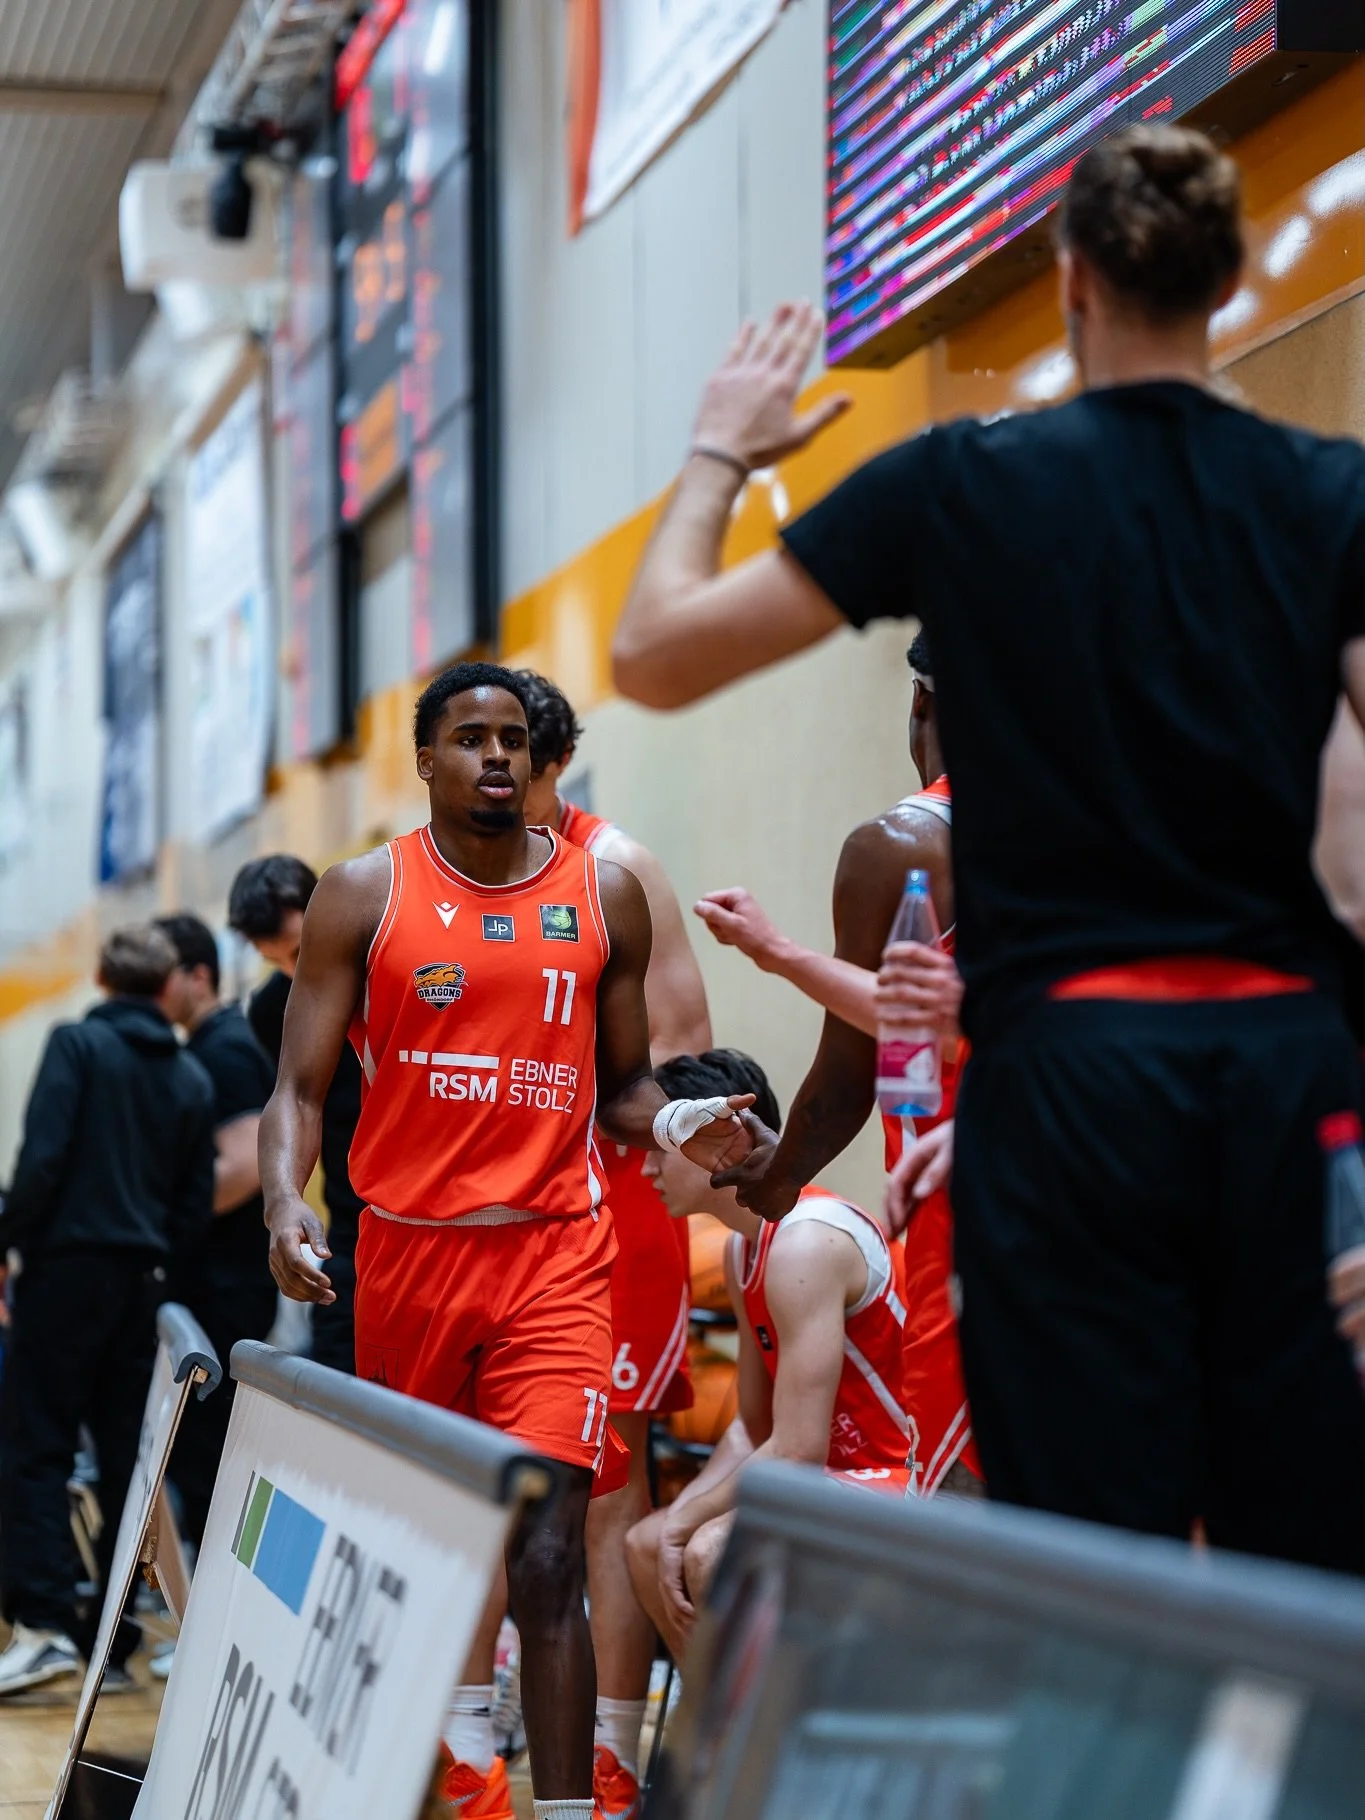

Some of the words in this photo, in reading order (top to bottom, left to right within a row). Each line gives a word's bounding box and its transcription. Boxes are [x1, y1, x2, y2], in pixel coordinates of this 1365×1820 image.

[545, 930, 577, 940] BARMER
[418, 987, 462, 998] DRAGONS
[542, 967, 577, 1026] 11
[429, 1072, 499, 1103] RSM
[509, 1057, 578, 1090] EBNER
[507, 1083, 577, 1114] STOLZ
[580, 1386, 608, 1448] 11
